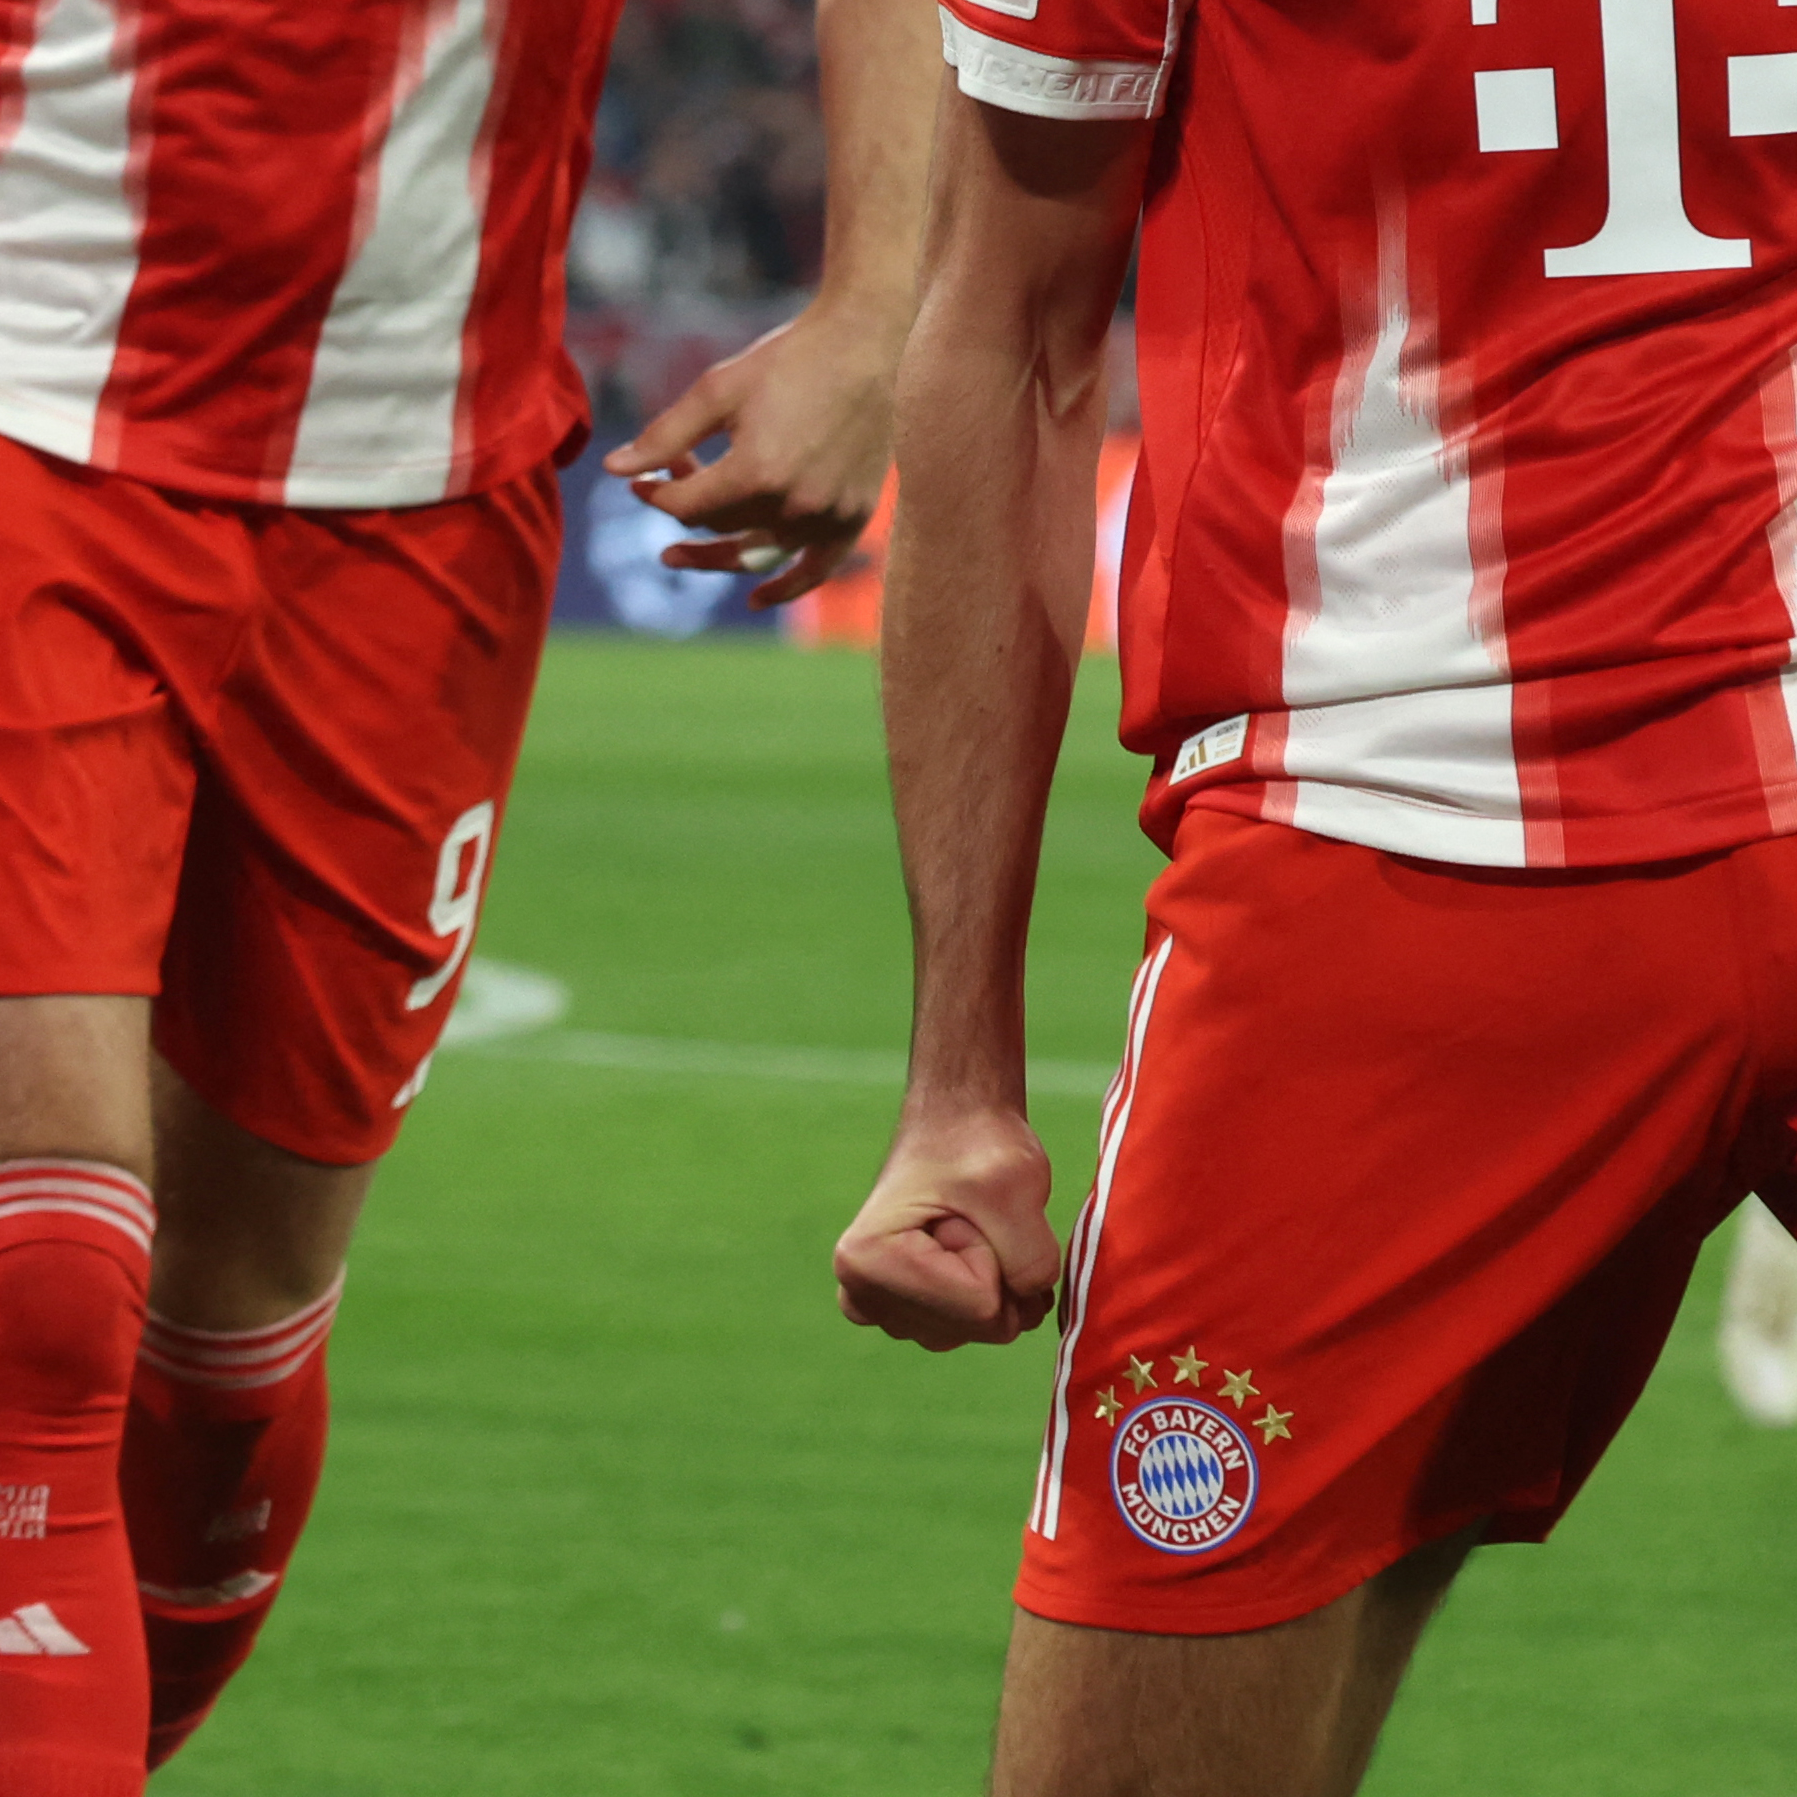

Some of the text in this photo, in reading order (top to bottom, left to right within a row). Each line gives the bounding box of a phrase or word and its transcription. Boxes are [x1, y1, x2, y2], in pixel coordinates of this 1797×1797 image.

[405, 799, 494, 1010] 9
[1123, 1408, 1245, 1471] FC BAYERN
